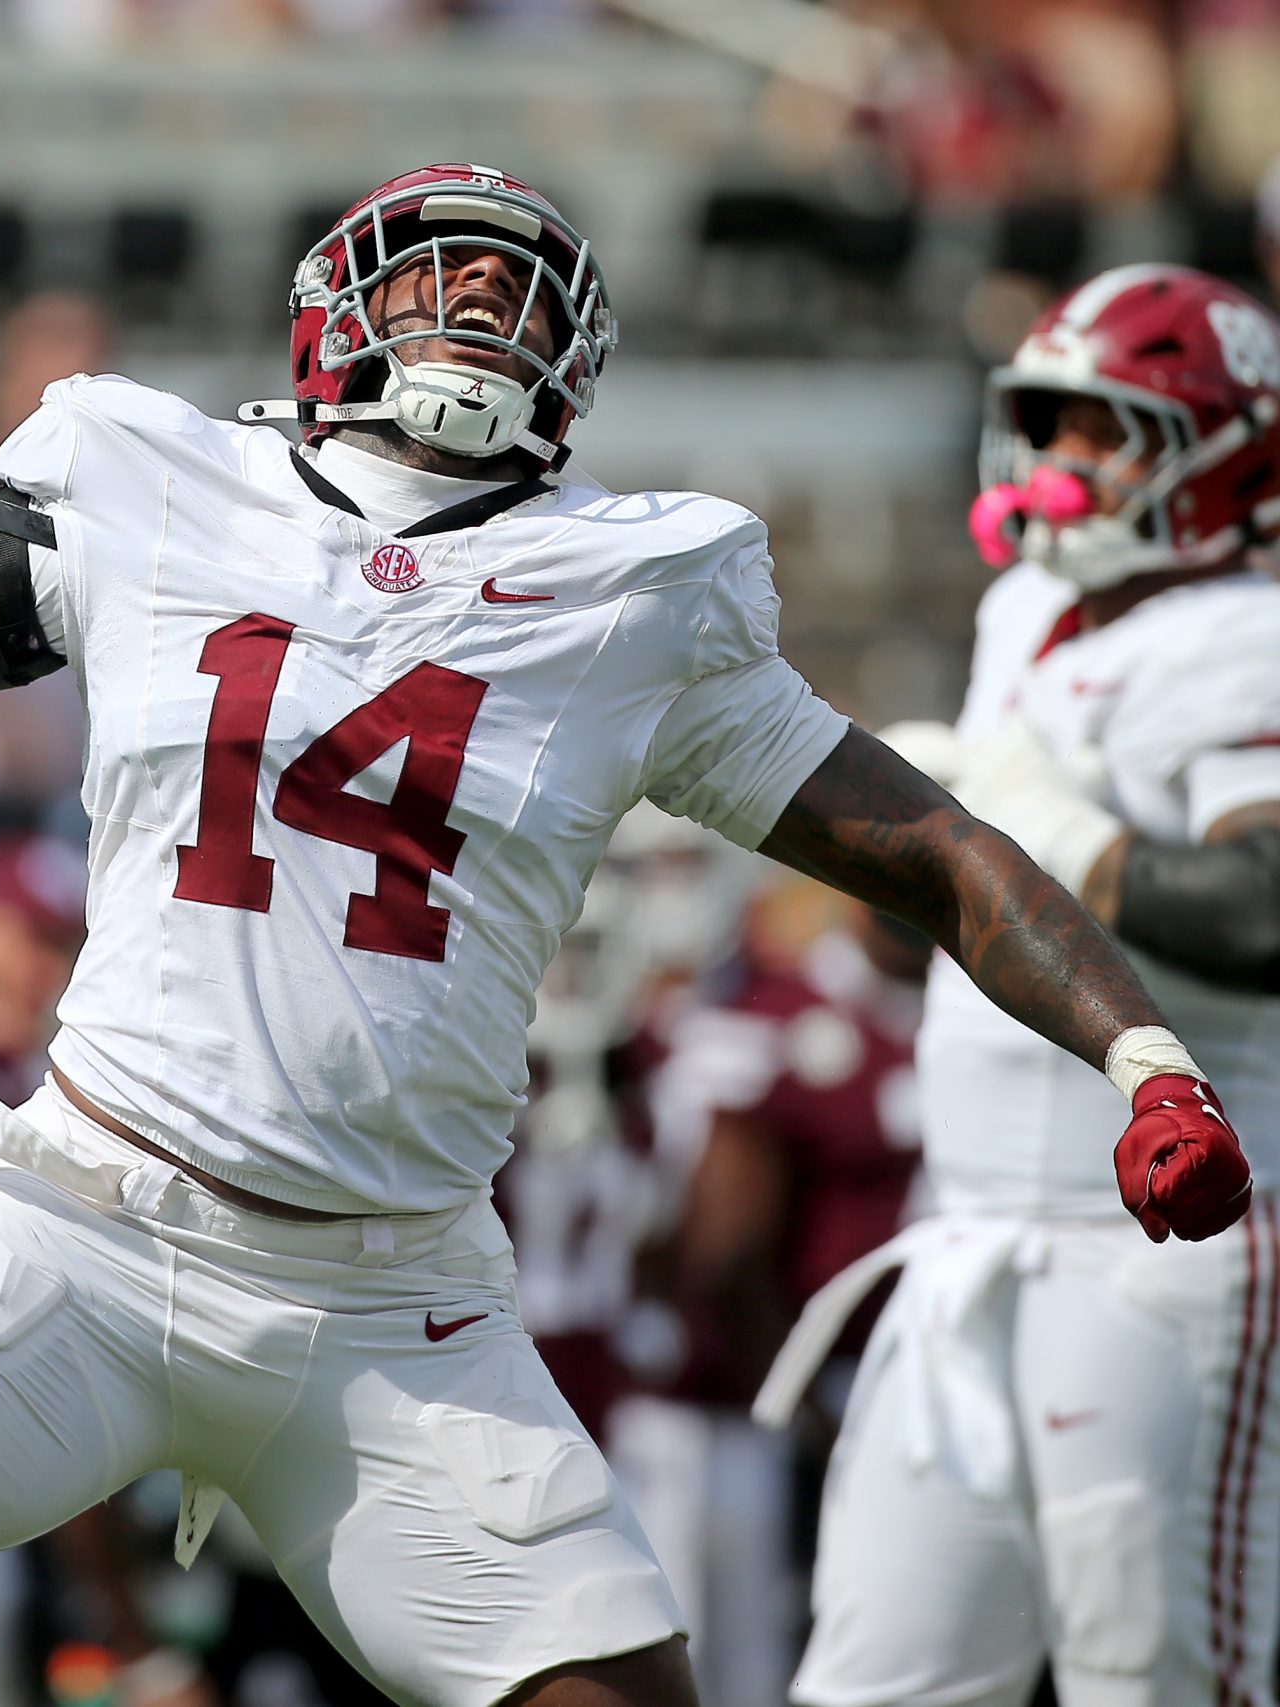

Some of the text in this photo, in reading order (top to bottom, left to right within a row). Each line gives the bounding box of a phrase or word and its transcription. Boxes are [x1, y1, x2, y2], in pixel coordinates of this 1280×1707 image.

[375, 545, 414, 581] SEC
[365, 572, 414, 591] GRADUATE
[173, 612, 490, 962] 14
